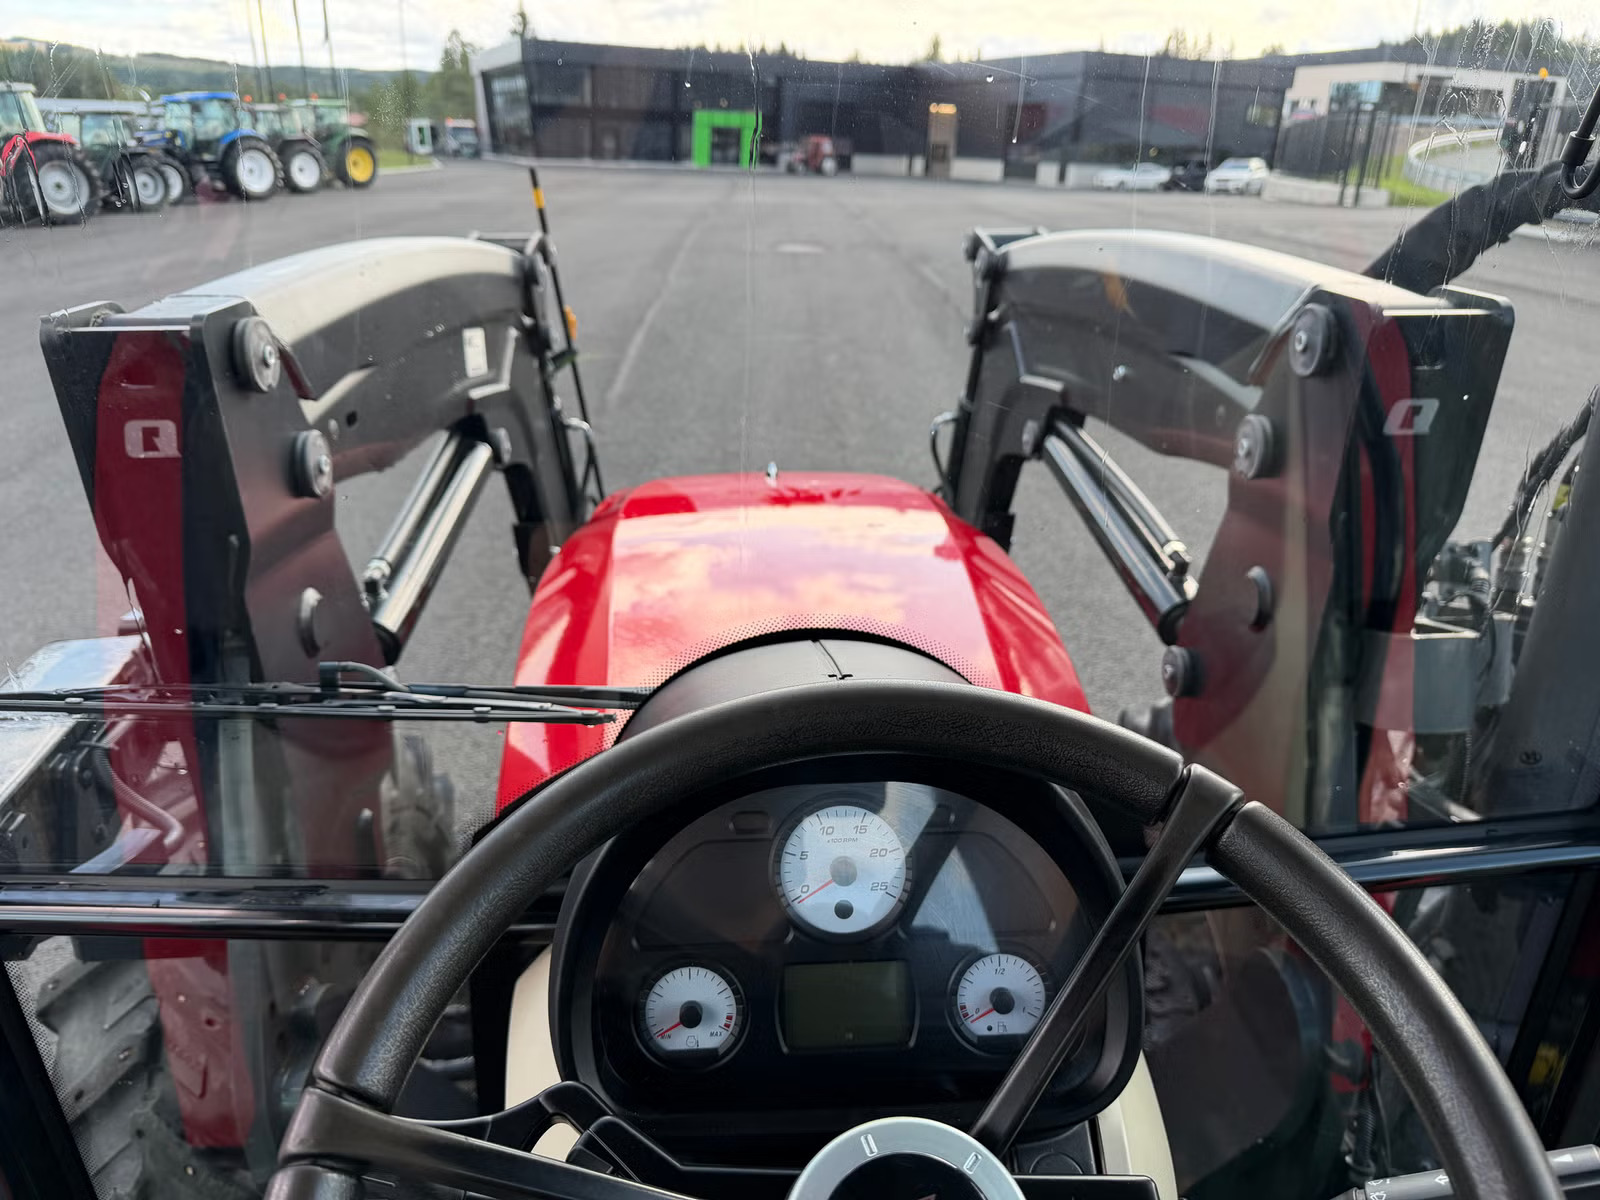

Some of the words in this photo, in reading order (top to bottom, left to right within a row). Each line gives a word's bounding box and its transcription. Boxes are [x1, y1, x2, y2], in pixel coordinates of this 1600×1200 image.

[124, 419, 181, 458] Q
[820, 826, 834, 835] 10
[853, 825, 868, 834] 15
[800, 851, 809, 860] 5
[869, 848, 888, 857] 20
[800, 884, 810, 894] 0
[870, 882, 888, 891] 25
